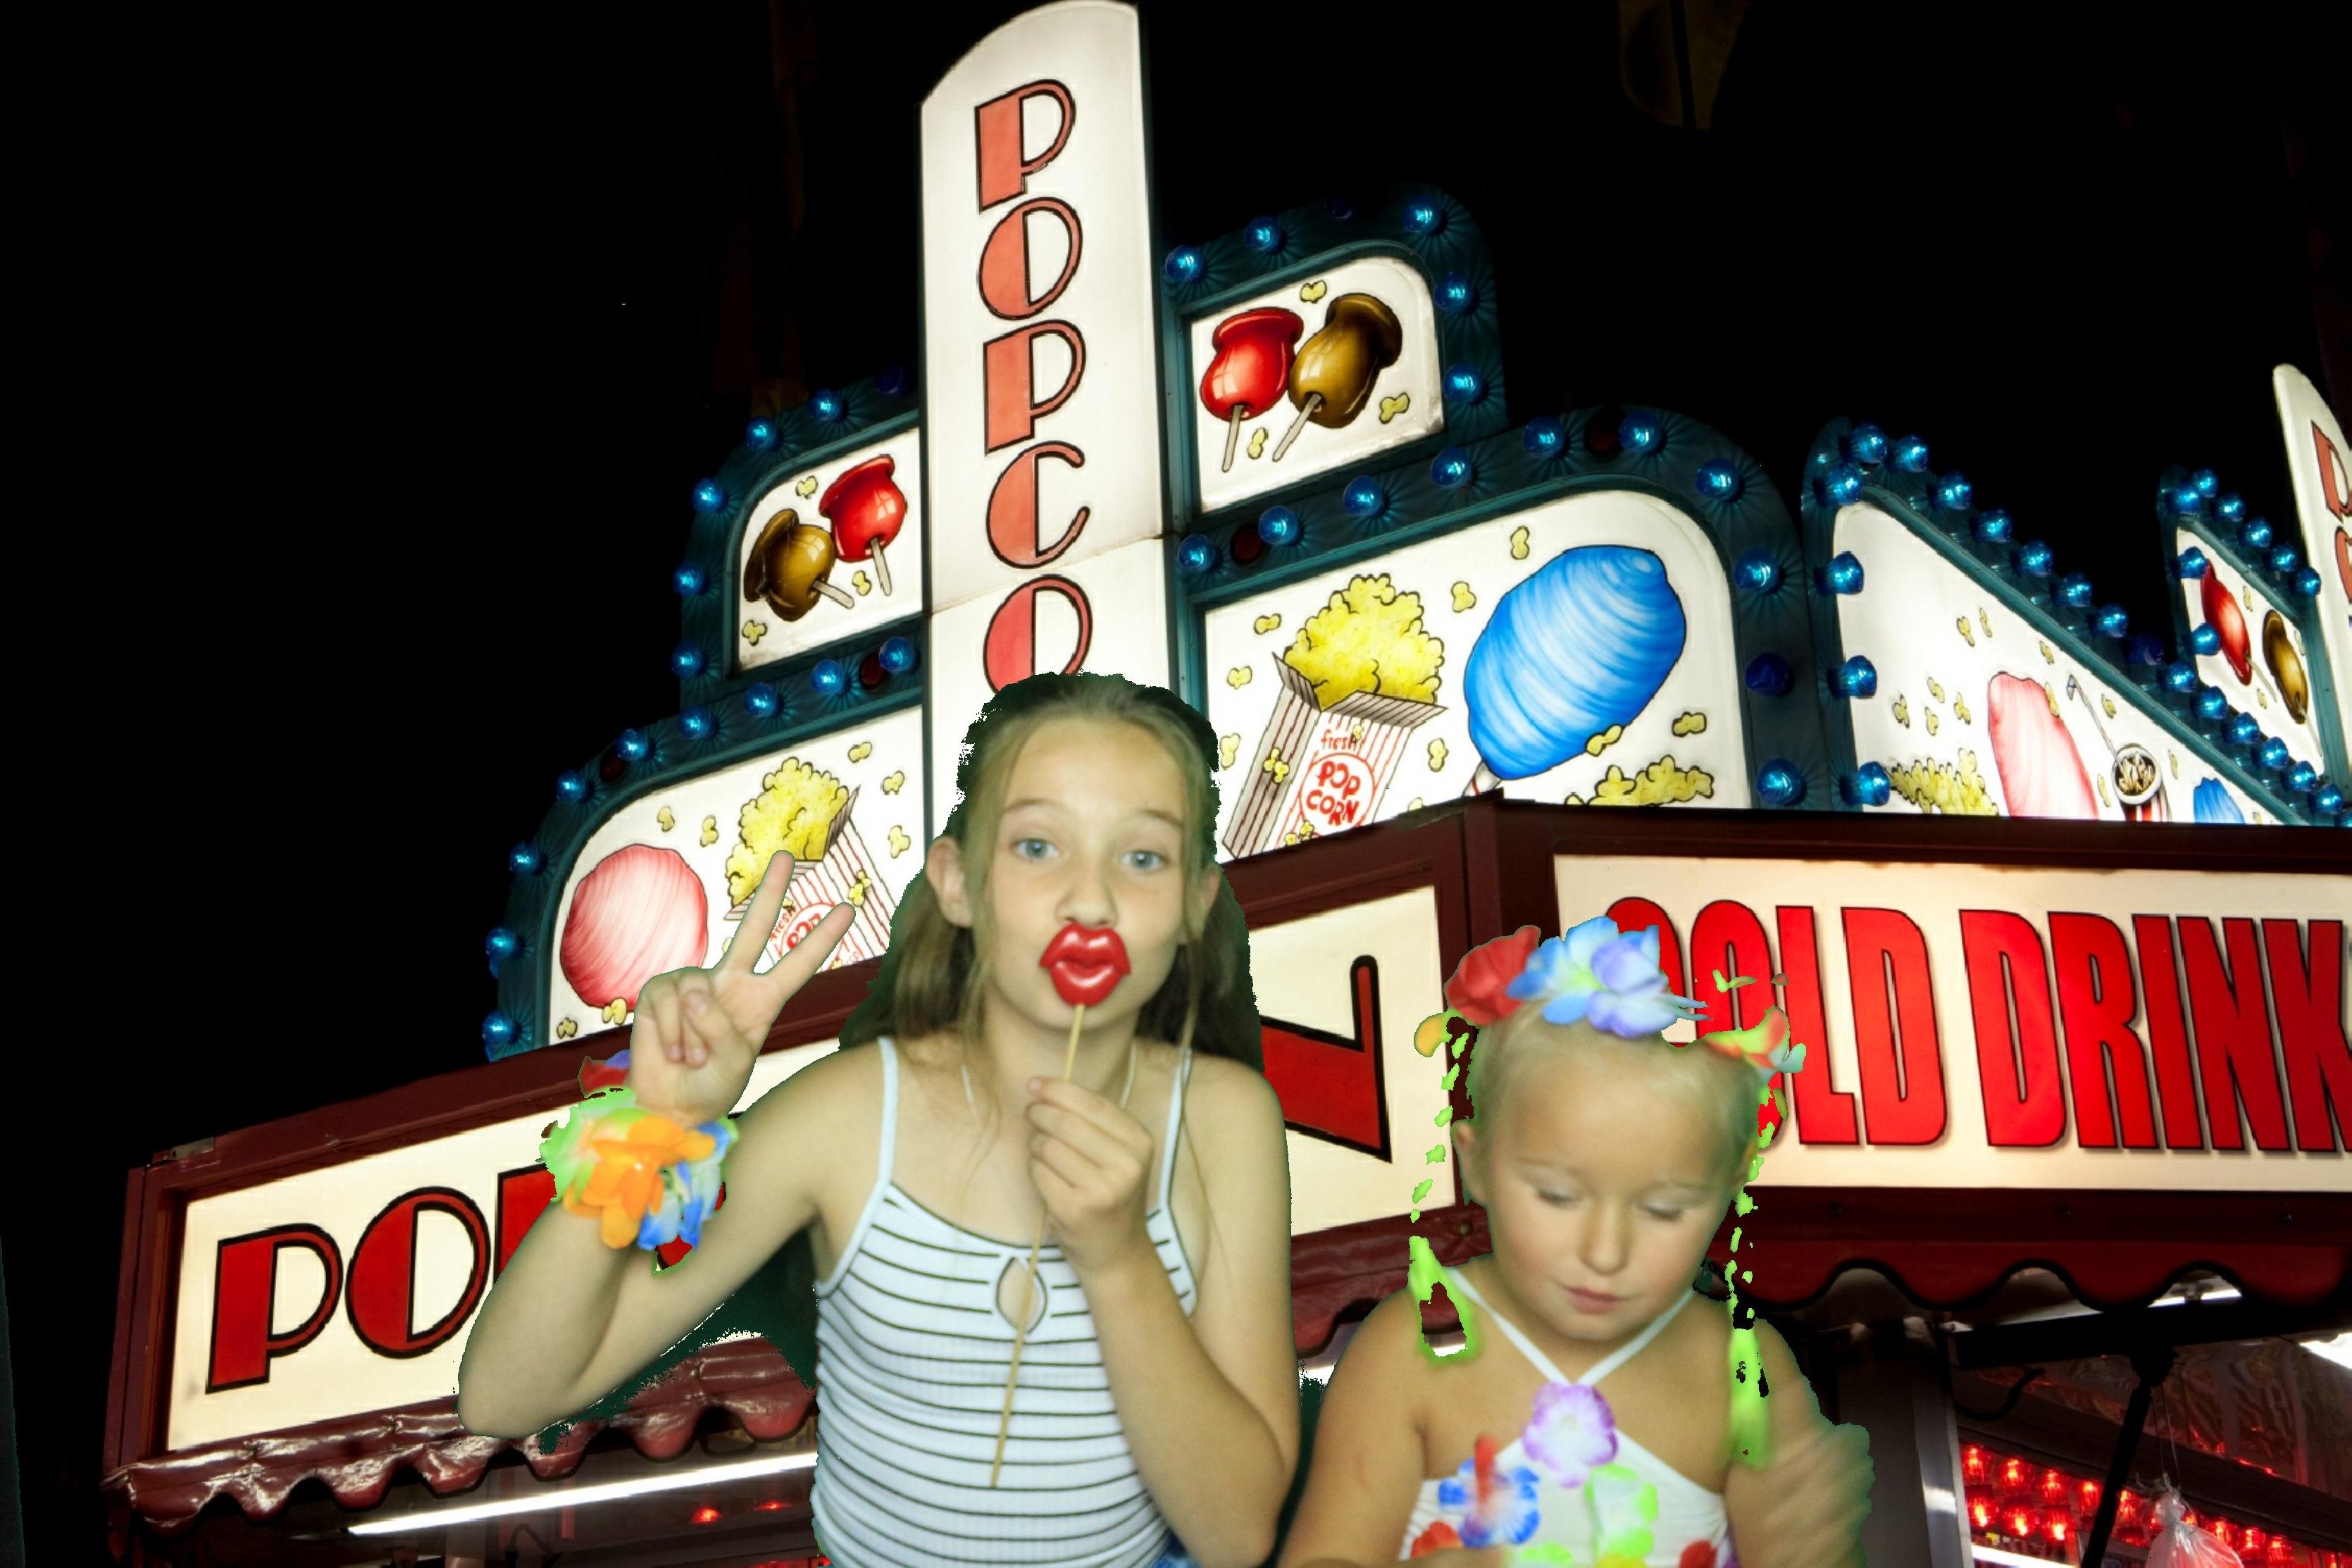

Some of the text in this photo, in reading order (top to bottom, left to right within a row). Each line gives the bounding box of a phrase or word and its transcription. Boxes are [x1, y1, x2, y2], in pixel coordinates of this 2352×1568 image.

[1321, 728, 1359, 752] fresh
[1317, 761, 1361, 800] POP
[1306, 789, 1360, 826] CORN
[1959, 909, 2352, 1152] DRINK
